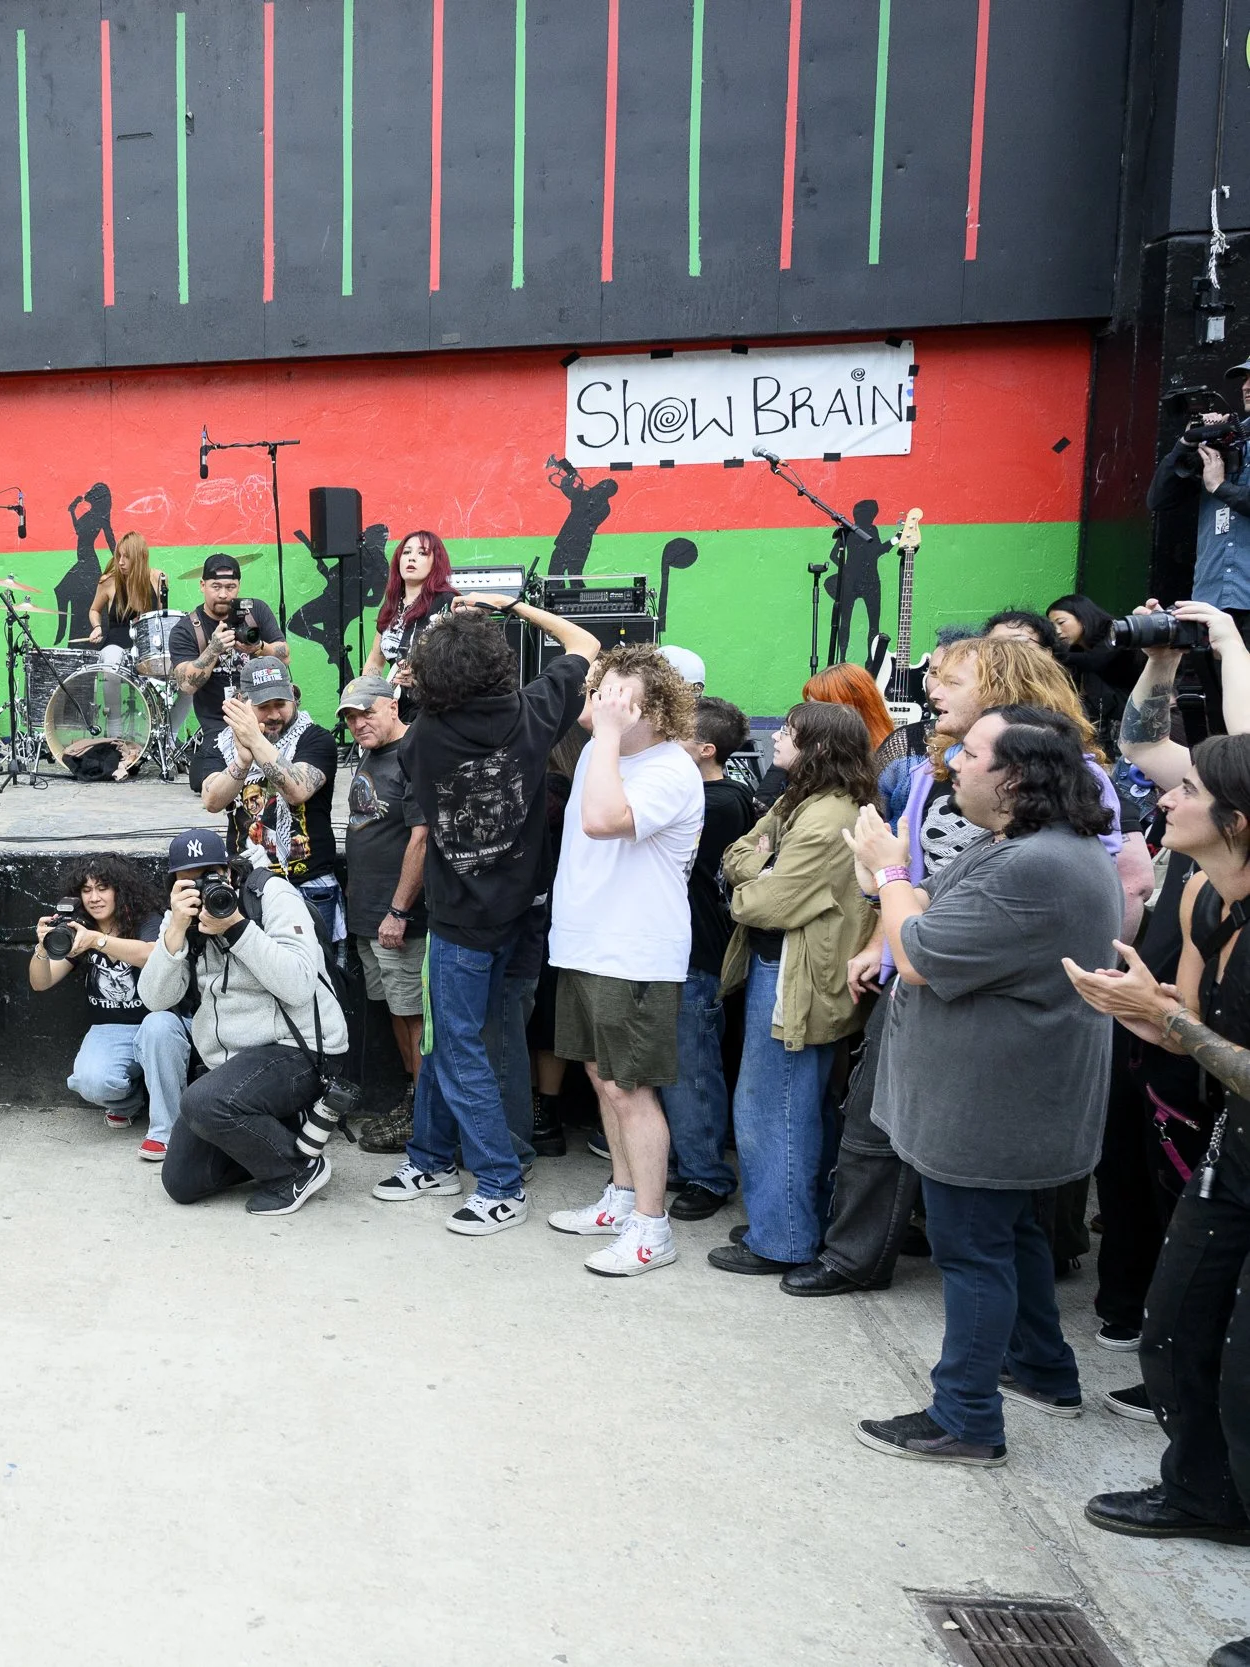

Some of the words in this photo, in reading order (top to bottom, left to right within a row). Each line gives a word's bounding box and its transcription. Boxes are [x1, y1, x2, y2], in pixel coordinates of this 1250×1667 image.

[252, 669, 269, 679] FREE
[253, 673, 283, 686] PALESTINE
[186, 838, 204, 858] NY
[99, 999, 121, 1009] THE
[122, 999, 143, 1009] MO
